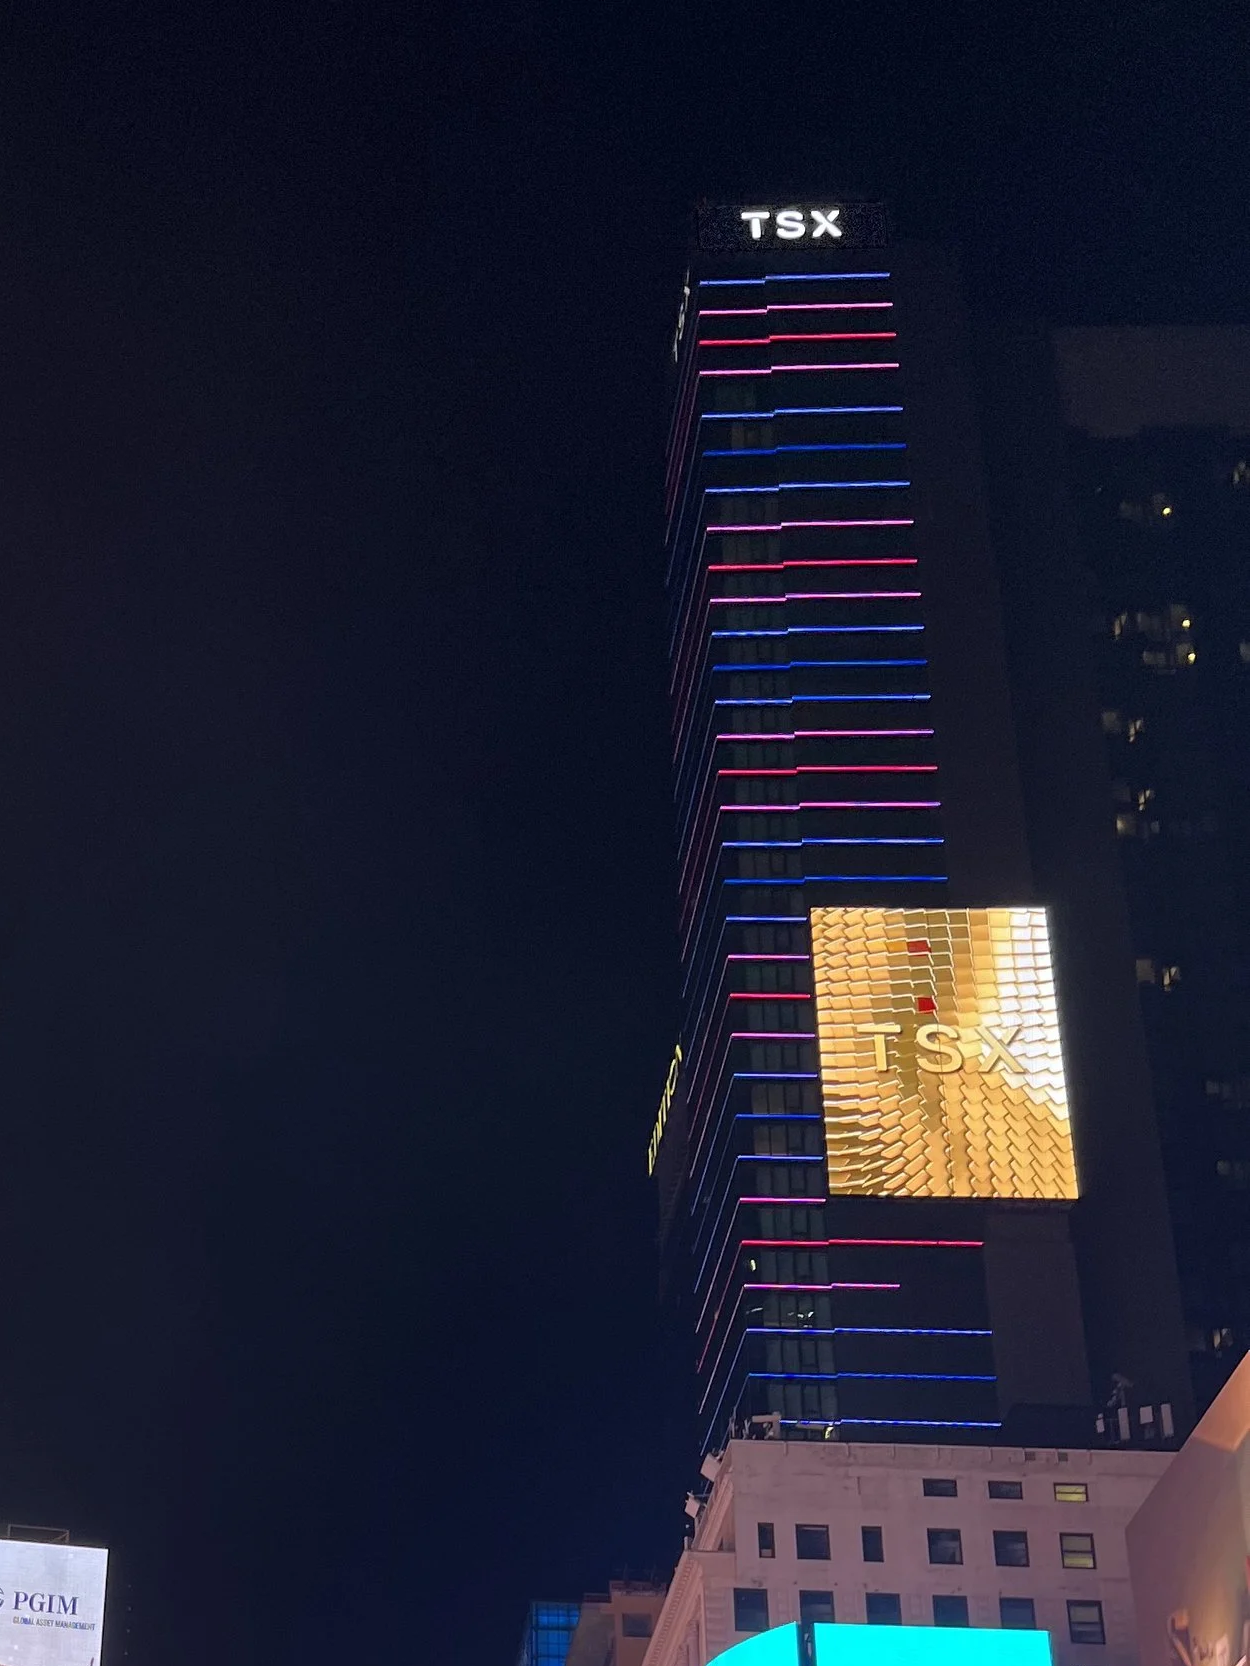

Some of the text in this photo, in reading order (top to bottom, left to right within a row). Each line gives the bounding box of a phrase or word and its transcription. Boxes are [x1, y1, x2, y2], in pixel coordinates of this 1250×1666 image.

[741, 210, 842, 239] TSX
[856, 1023, 1026, 1073] TSX
[12, 1591, 79, 1615] PGIM
[12, 1616, 95, 1631] GLOBAL ASSET MANAGEMENT
